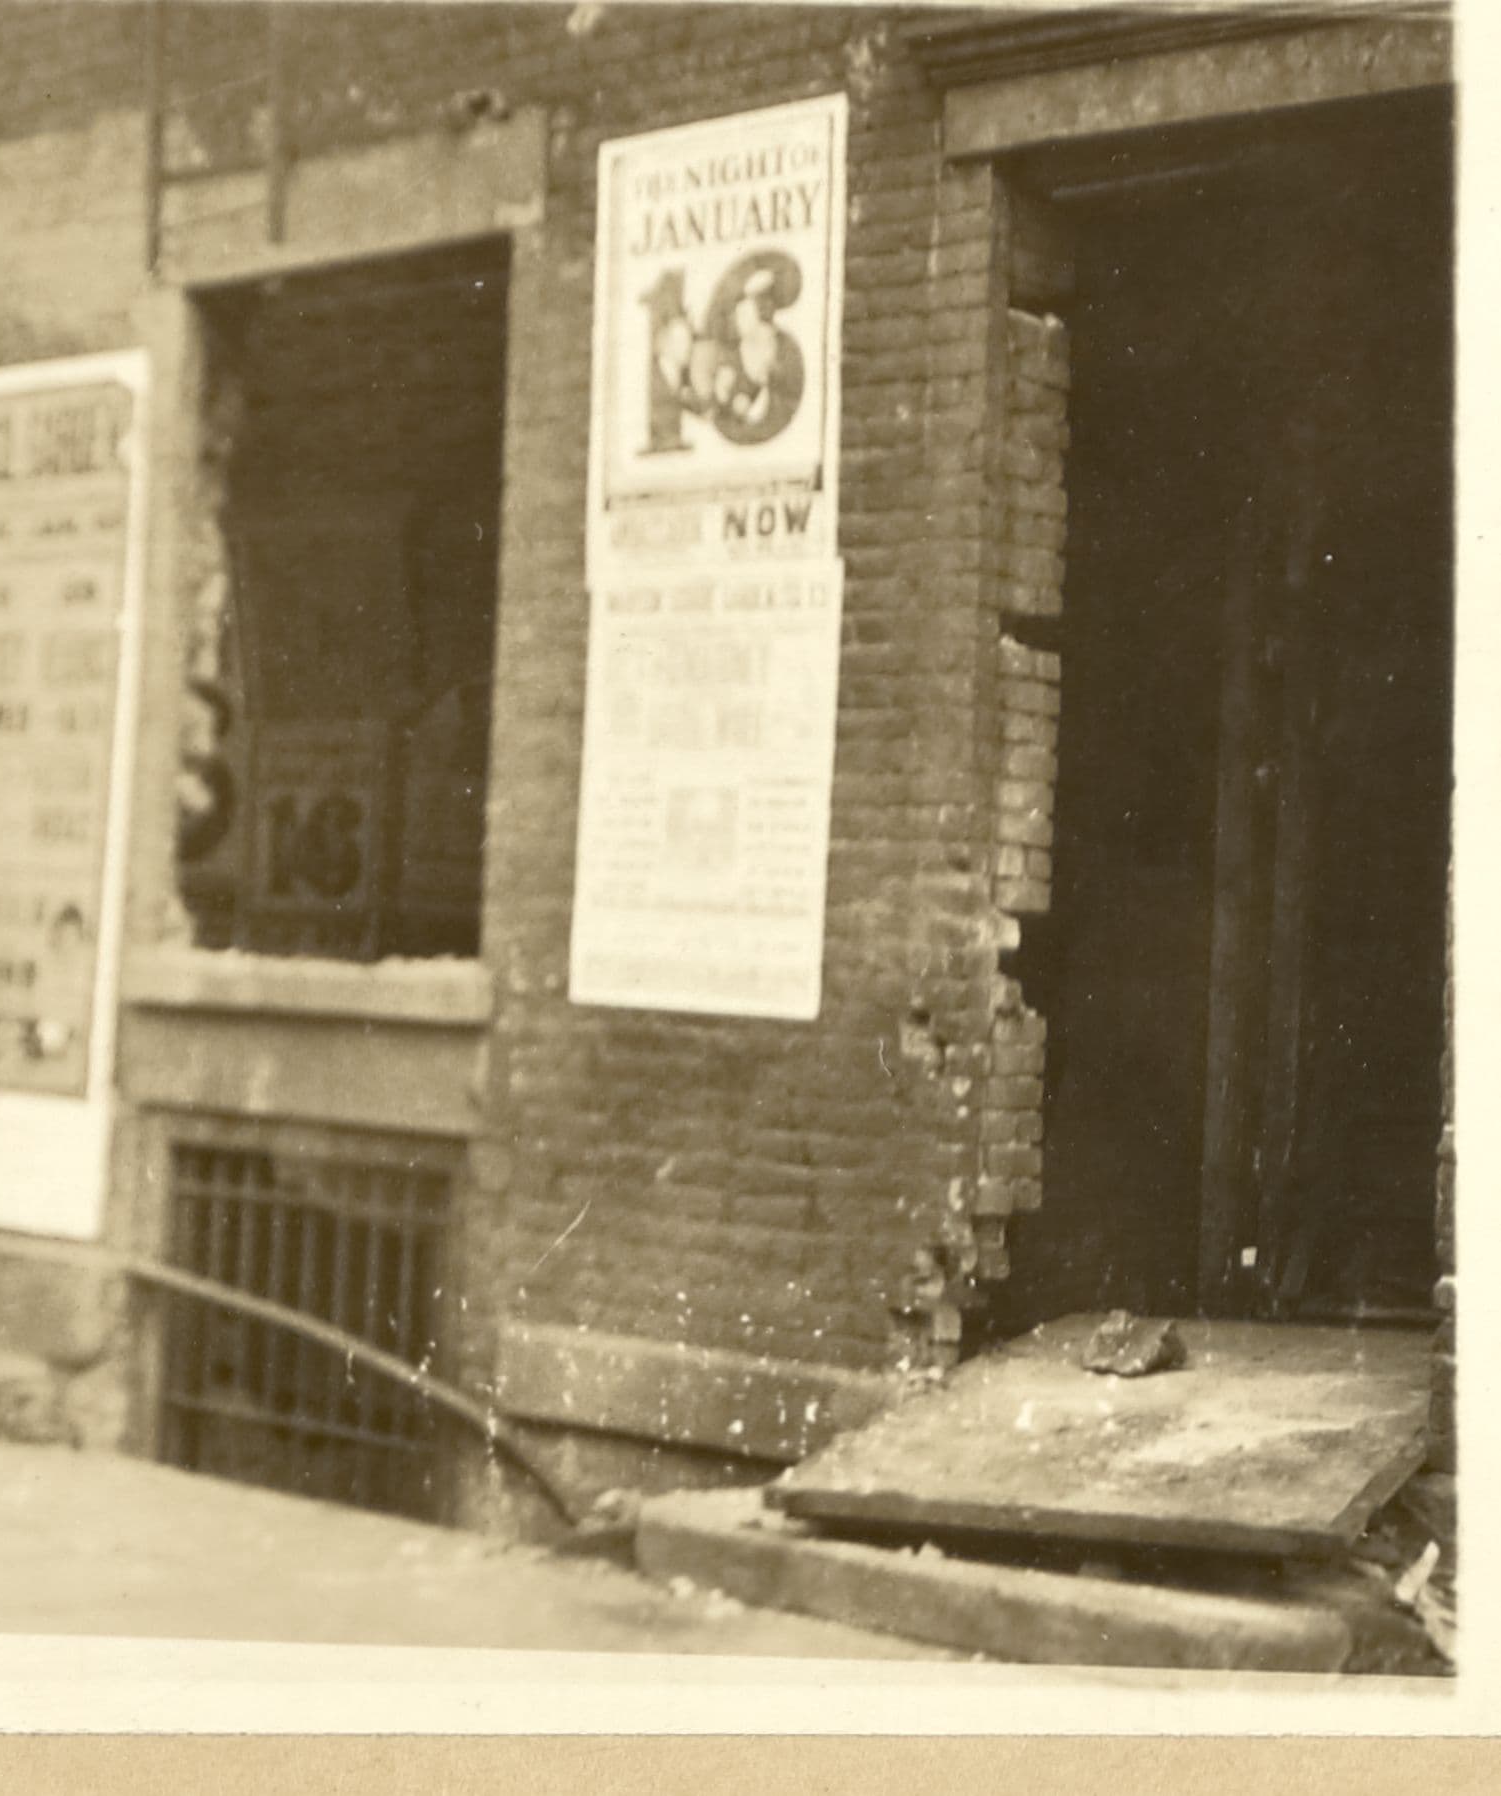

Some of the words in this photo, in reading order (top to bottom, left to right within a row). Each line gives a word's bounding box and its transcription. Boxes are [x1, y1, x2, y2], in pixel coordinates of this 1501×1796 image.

[684, 145, 786, 190] NIGHT
[630, 179, 821, 257] JANUARY
[637, 249, 805, 456] 16
[723, 499, 812, 540] NOW
[268, 790, 363, 898] 16
